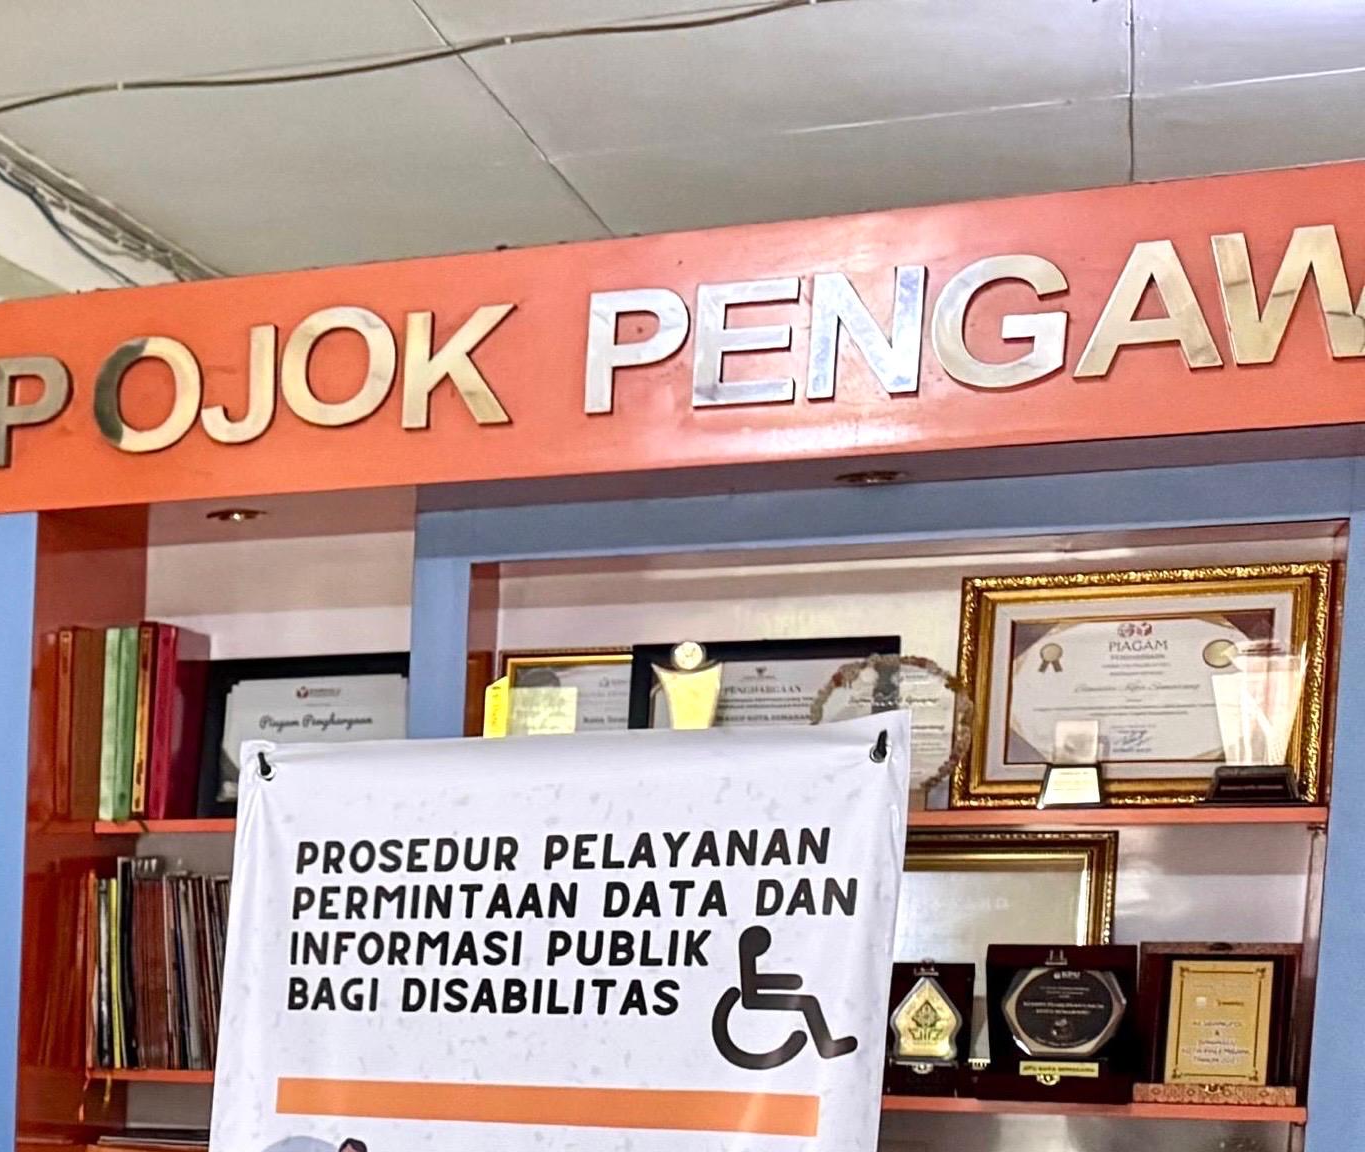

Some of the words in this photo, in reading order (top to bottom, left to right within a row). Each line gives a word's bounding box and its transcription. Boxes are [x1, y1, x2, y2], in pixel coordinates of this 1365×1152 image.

[296, 835, 519, 875] PROSEDUR
[543, 827, 831, 870] PELAYANAN
[292, 881, 578, 920] PERMINTAAN
[603, 879, 728, 918] DATA
[755, 877, 858, 917] DAN
[289, 930, 521, 967] INFORMASI
[547, 929, 711, 968] PUBLIK
[287, 977, 378, 1012] BAGI
[401, 977, 680, 1016] DISABILITAS
